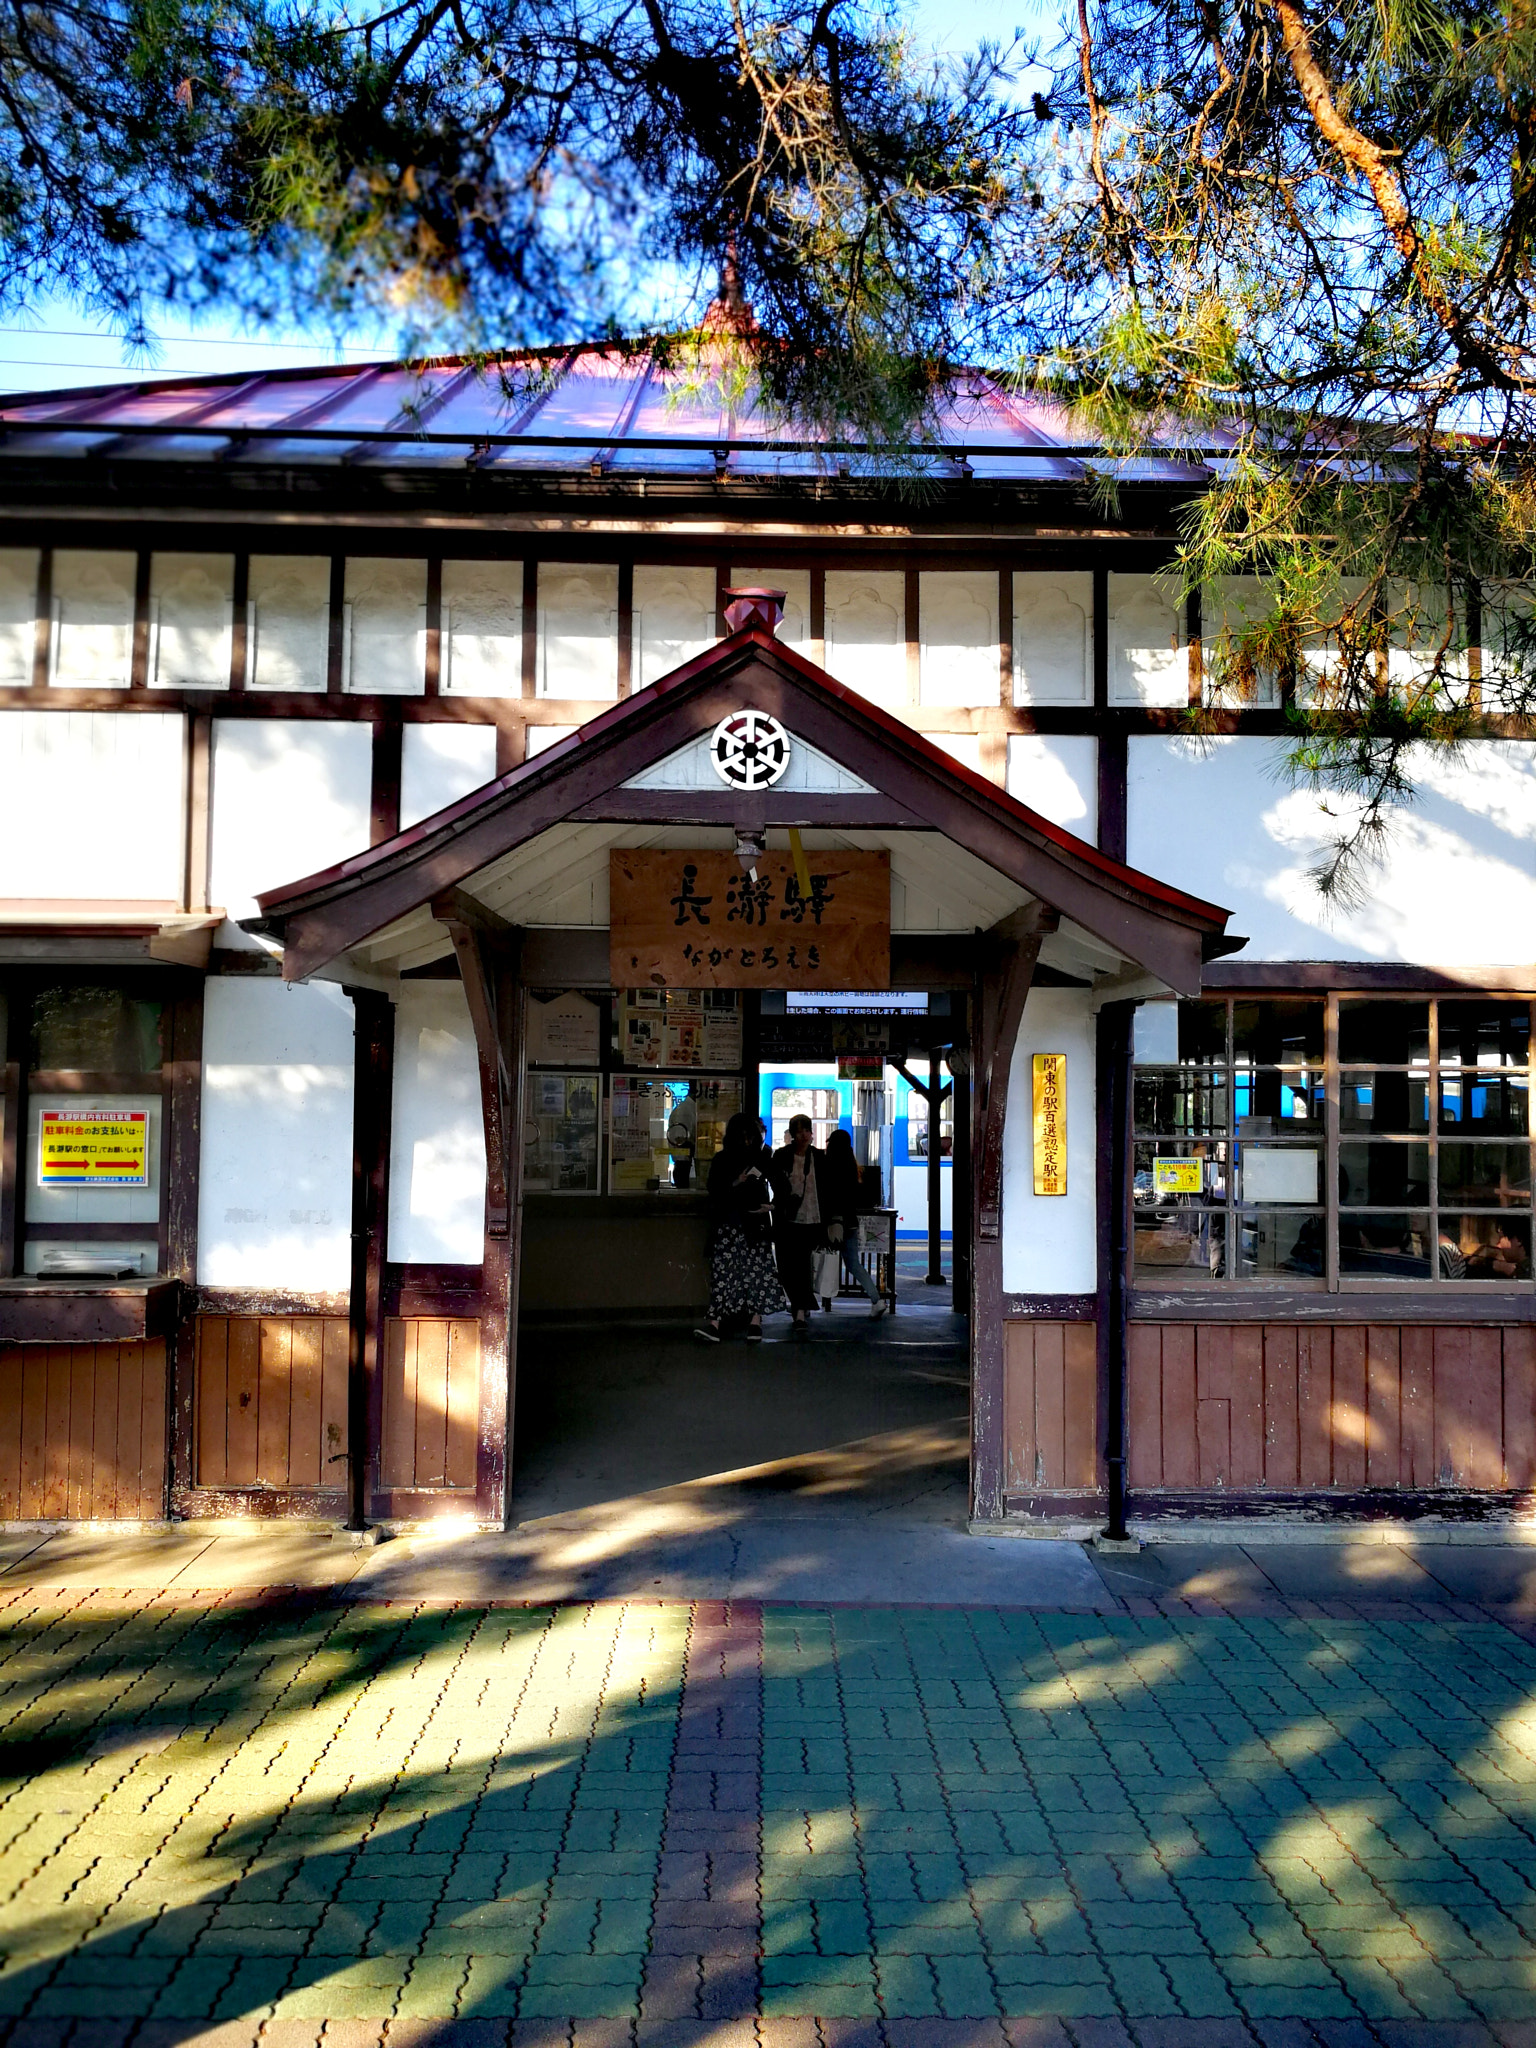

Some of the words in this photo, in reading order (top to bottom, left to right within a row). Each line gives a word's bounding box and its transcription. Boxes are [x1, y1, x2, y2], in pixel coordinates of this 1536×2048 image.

[683, 944, 821, 970] ながとろえき
[1042, 1057, 1058, 1177] 関東の駅百選認定駅
